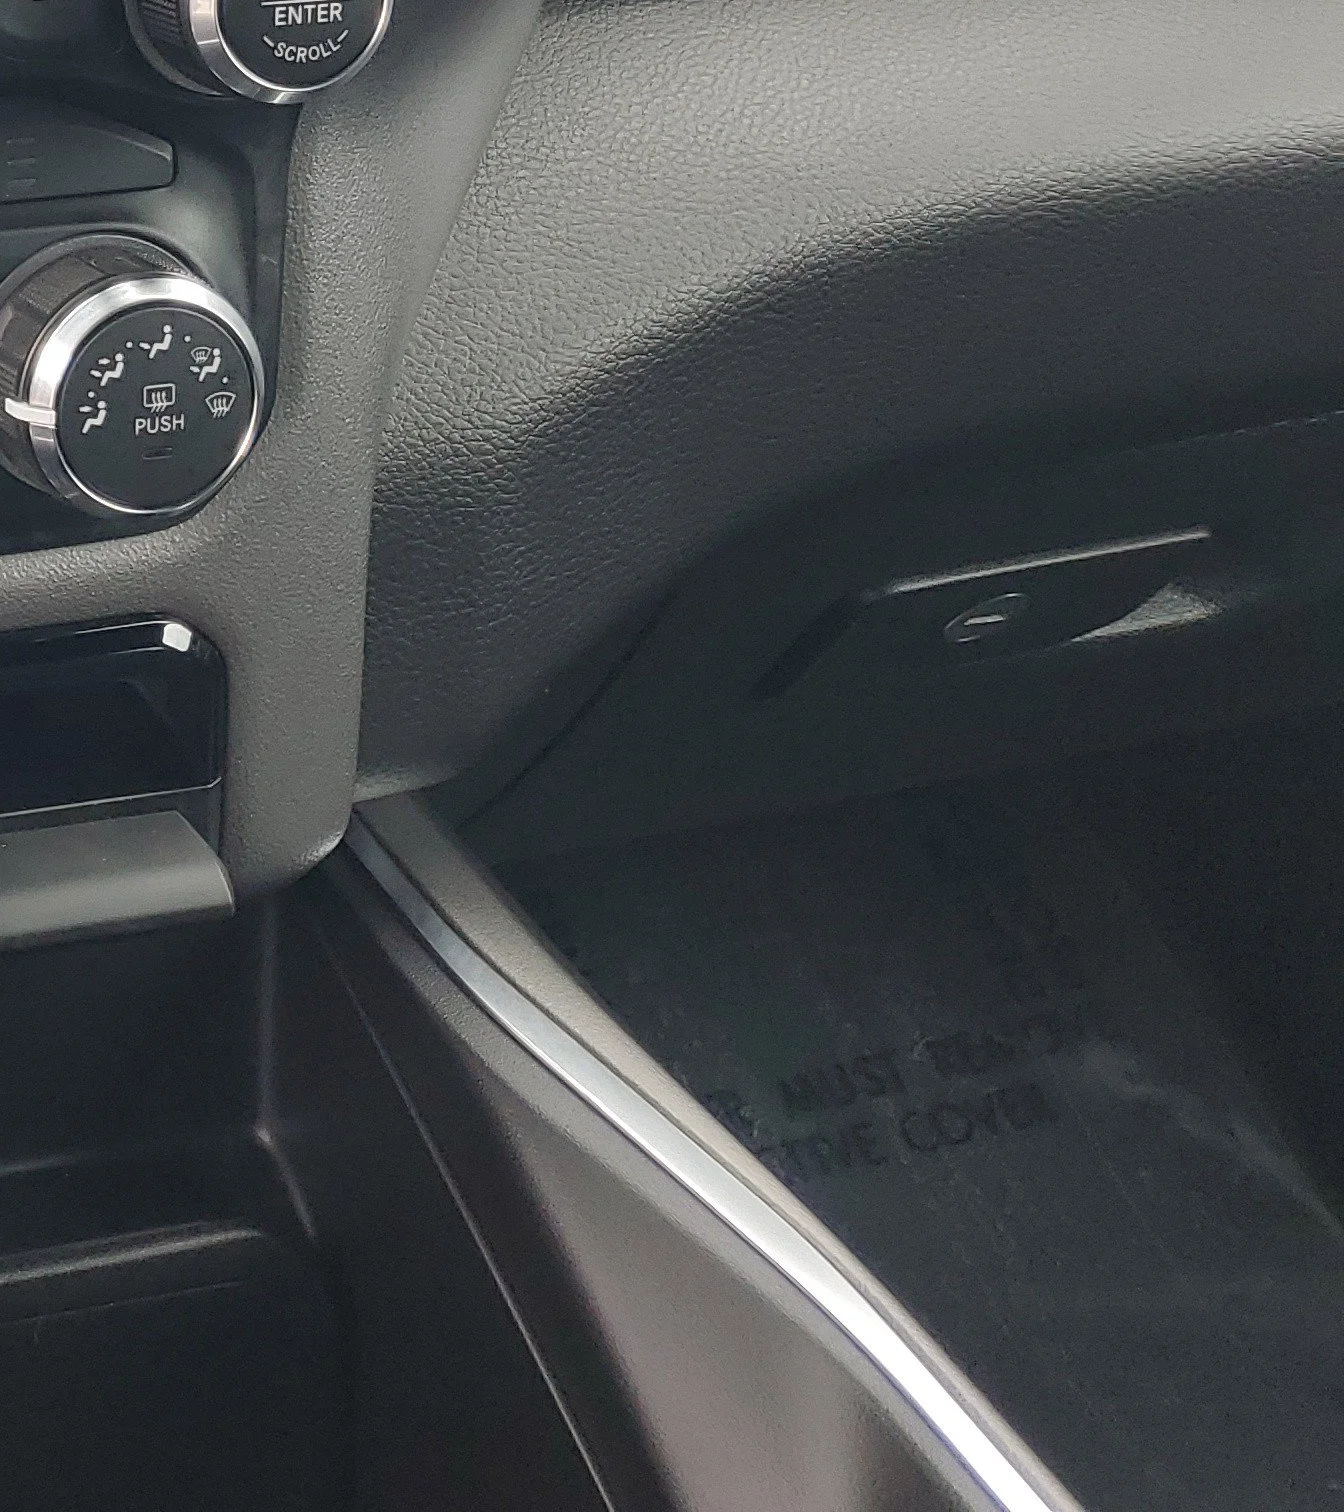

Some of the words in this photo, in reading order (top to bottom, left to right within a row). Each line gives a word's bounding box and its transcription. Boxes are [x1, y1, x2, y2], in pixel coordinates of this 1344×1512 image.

[273, 3, 344, 28] ENTER
[273, 40, 342, 64] SCROLL
[134, 414, 185, 436] PUSH
